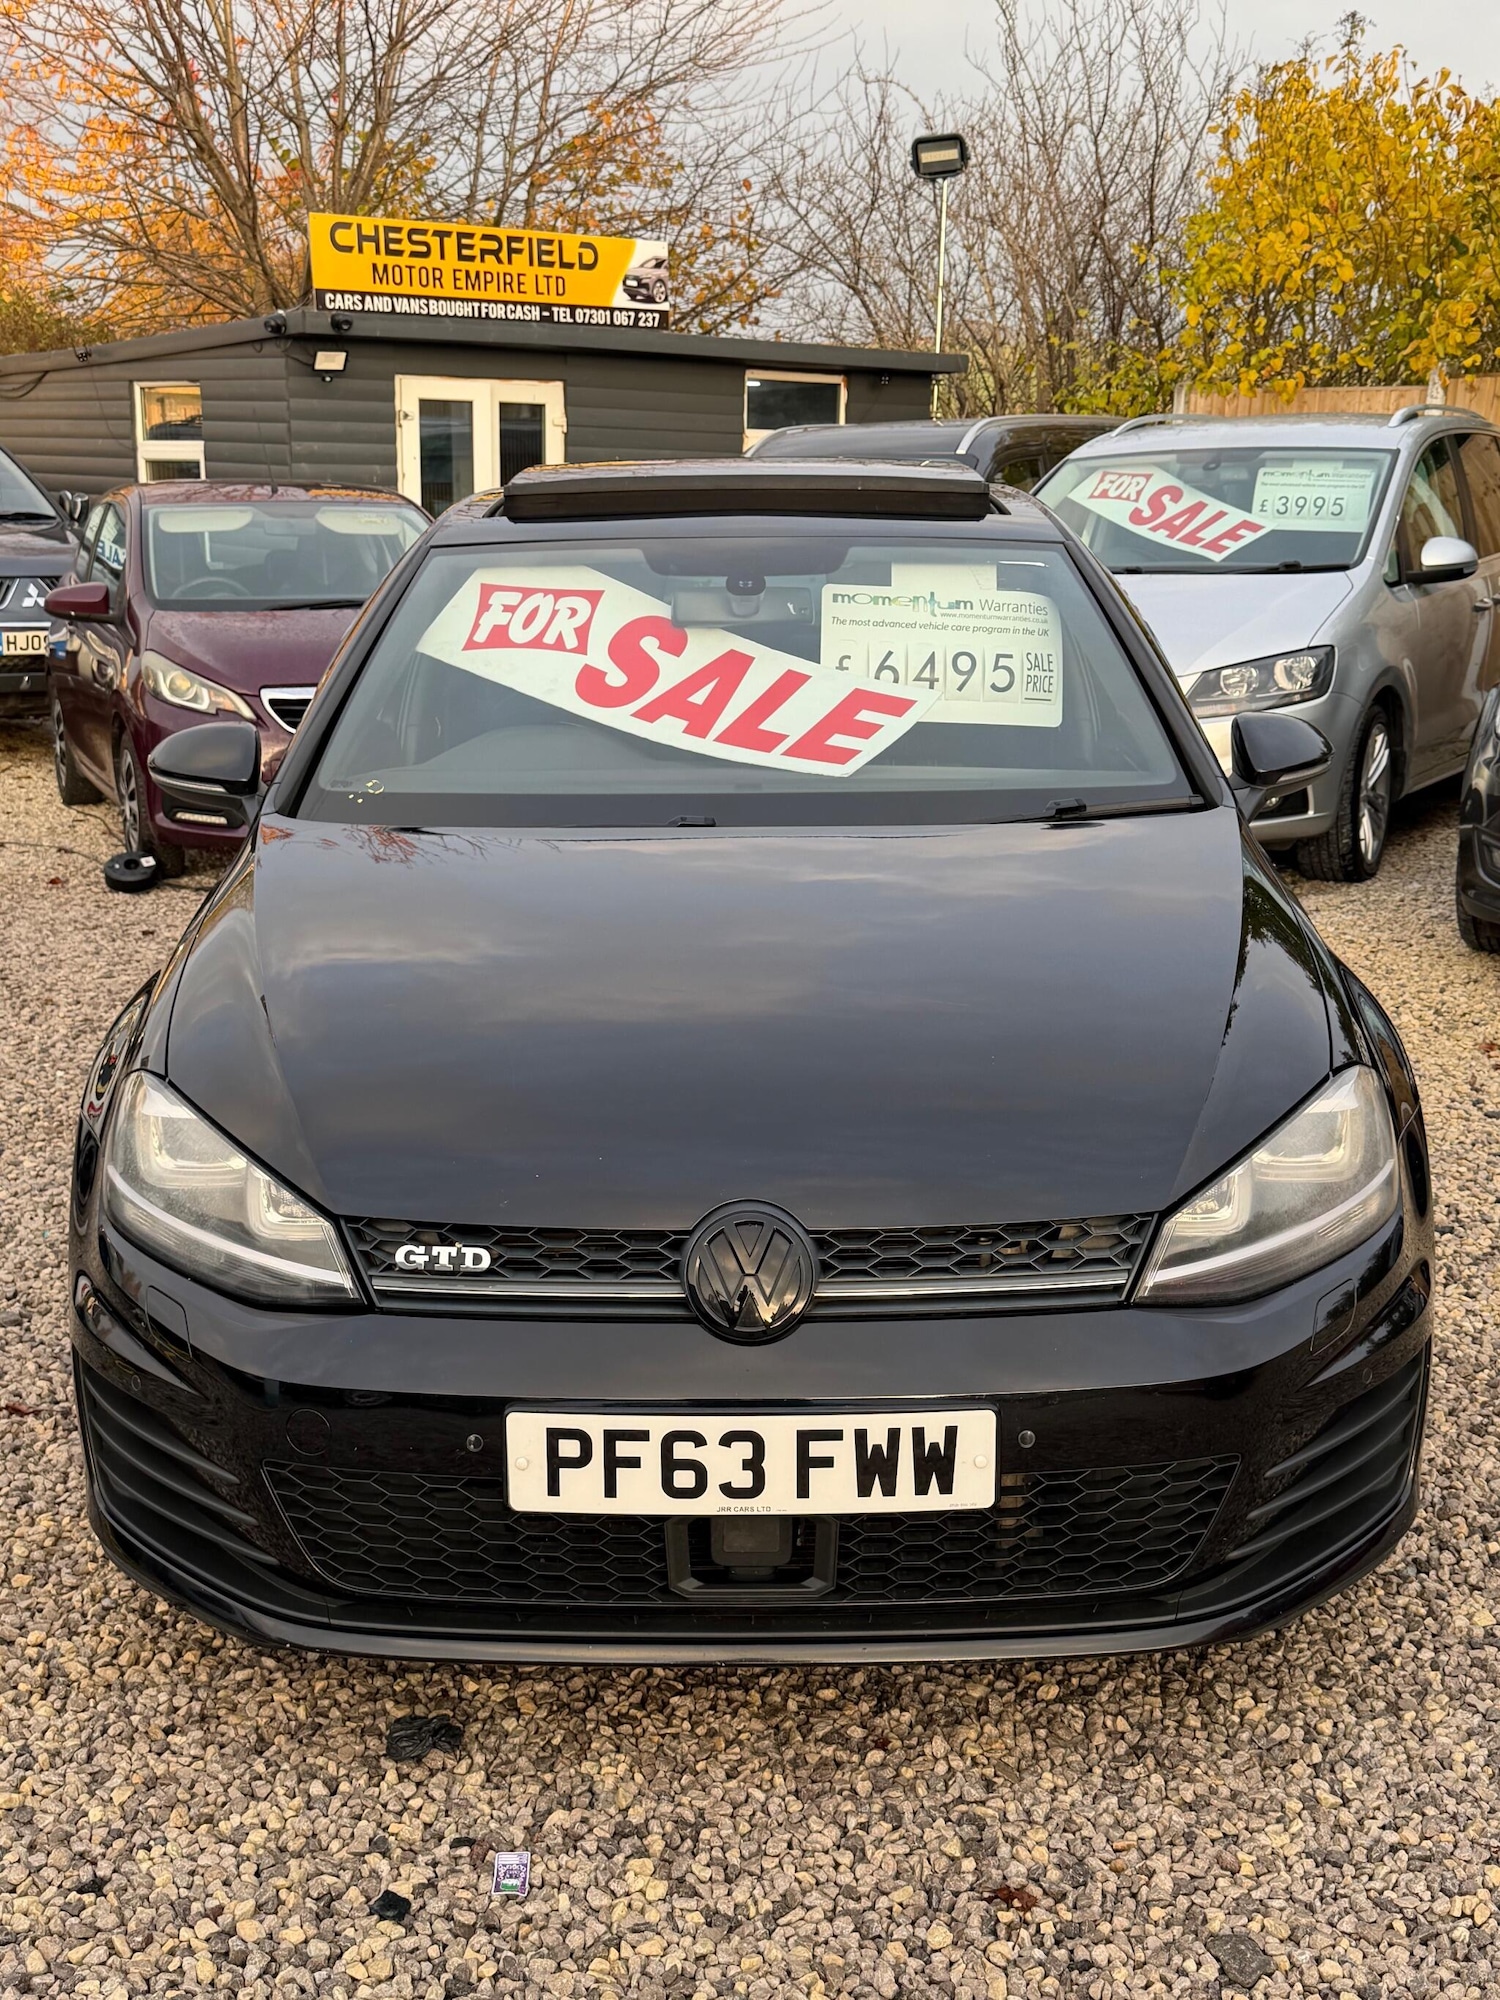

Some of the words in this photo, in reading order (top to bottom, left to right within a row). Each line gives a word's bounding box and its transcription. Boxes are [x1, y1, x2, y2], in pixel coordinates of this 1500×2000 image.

[330, 221, 599, 271] CHESTERFIELD
[372, 263, 444, 289] MOTOR
[453, 269, 527, 294] EMPIRE
[535, 274, 566, 297] LTD
[325, 293, 363, 311] CARS
[364, 296, 392, 313] AND
[392, 298, 428, 315] VANS
[429, 300, 481, 318] BOUGHT
[481, 303, 506, 319] FOR
[506, 304, 541, 321] CASH
[552, 307, 573, 323] TEL
[575, 308, 611, 325] 07301
[613, 310, 635, 327] 067
[637, 312, 660, 328] 237
[1093, 473, 1147, 501] FOR
[1128, 485, 1266, 554] SALE
[1259, 499, 1269, 513] £
[1276, 495, 1345, 516] 3995
[473, 591, 593, 650] FOR
[832, 591, 974, 617] momentum
[978, 599, 1049, 616] Warranties
[831, 616, 847, 626] The
[848, 618, 871, 627] most
[872, 619, 917, 629] advanced
[918, 621, 950, 631] vehicle
[950, 623, 971, 632] care
[972, 625, 1011, 635] program
[1012, 626, 1021, 635] in
[1022, 627, 1036, 636] the
[1037, 628, 1050, 637] UK
[874, 649, 1016, 694] 6495
[1026, 652, 1054, 673] SALE
[575, 615, 918, 765] SALE
[1025, 674, 1054, 694] PRICE
[395, 1244, 492, 1272] GTD
[546, 1427, 766, 1499] PF63
[796, 1425, 959, 1499] FWW
